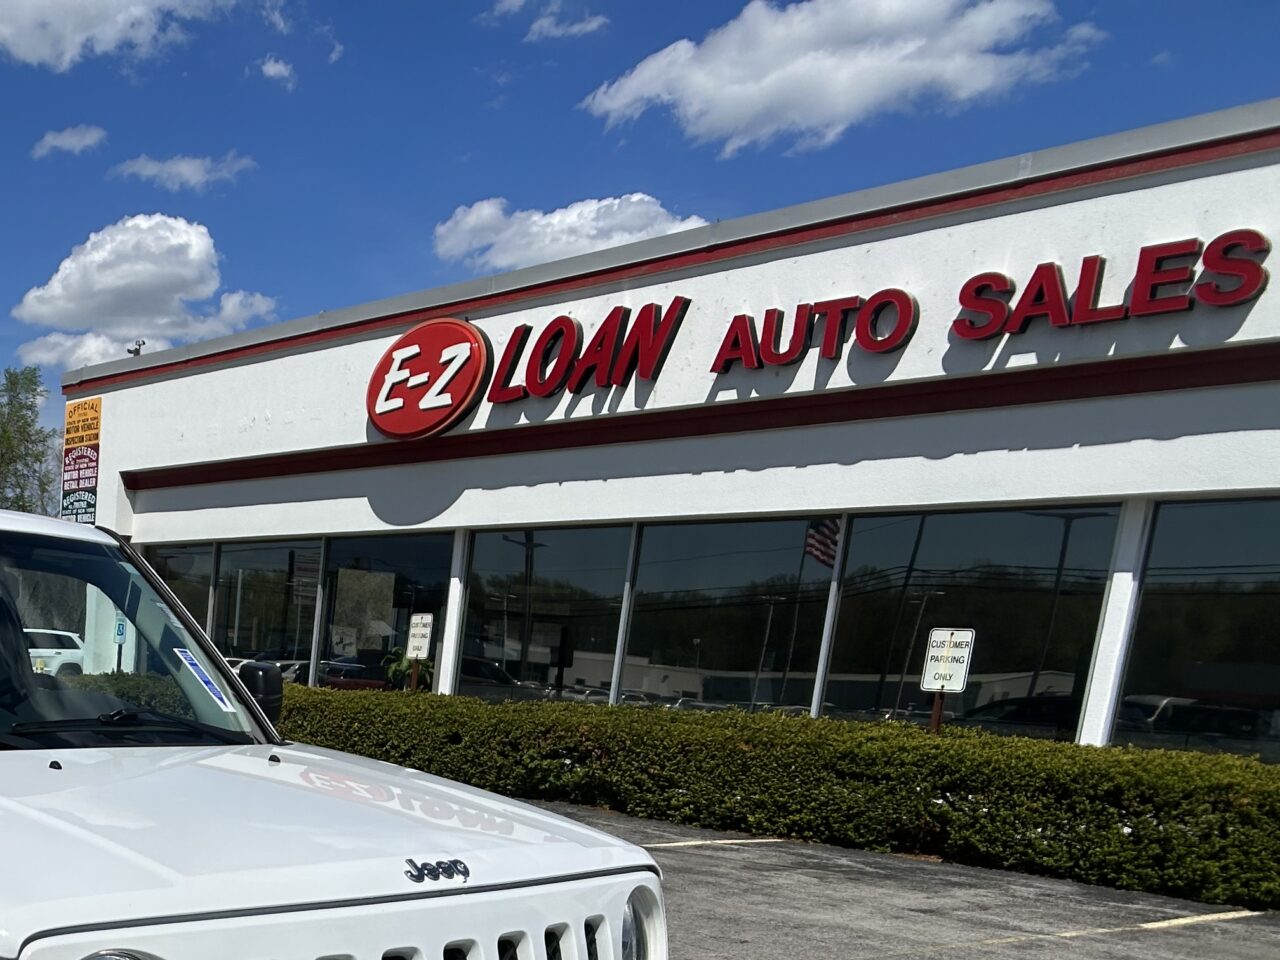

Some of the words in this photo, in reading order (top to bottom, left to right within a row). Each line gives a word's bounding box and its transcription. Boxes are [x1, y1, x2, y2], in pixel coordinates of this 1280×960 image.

[375, 342, 471, 415] E-Z
[487, 295, 692, 404] LOAN
[710, 288, 921, 374] AUTO
[953, 228, 1272, 341] SALES
[68, 401, 98, 419] OFFICIAL
[66, 425, 80, 434] MOTOR
[81, 421, 99, 432] VEHICLE
[65, 435, 84, 446] INSPECTION
[84, 432, 99, 442] STATION
[65, 446, 98, 465] REGISTERED
[64, 470, 79, 480] MOTOR
[80, 467, 97, 478] VEHICLE
[64, 480, 79, 490] RETAIL
[79, 477, 96, 488] DEALER
[63, 491, 96, 507] REGISTERED
[77, 513, 95, 523] VEHICLE
[931, 640, 970, 649] CUSTOMER
[930, 655, 965, 664] PARKING
[933, 672, 953, 681] ONLY
[404, 858, 470, 884] Jeep
